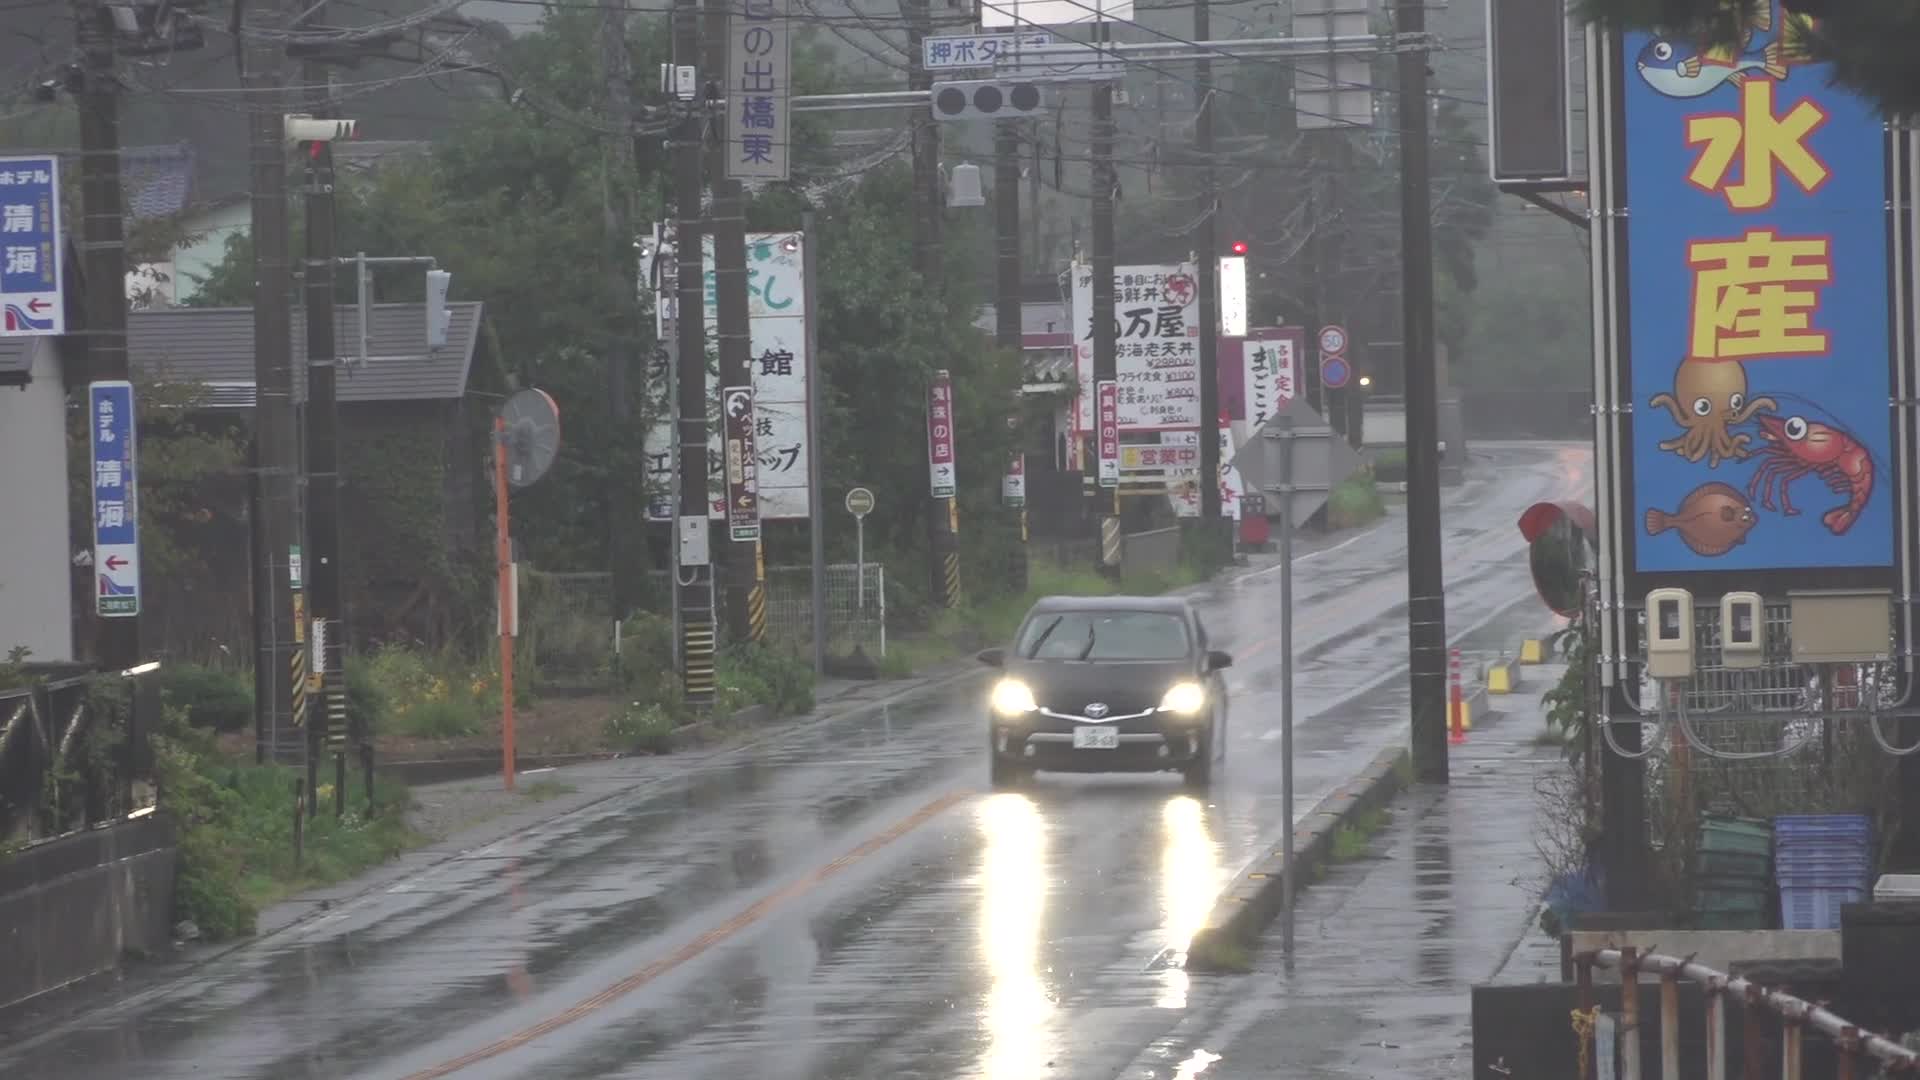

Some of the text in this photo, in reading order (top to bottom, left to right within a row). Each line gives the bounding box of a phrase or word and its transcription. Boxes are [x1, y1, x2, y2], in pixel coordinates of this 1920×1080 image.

[741, 0, 775, 164] 日の出橋東
[0, 170, 49, 185] ホテル
[1684, 75, 1832, 361] 水産
[1325, 334, 1341, 348] 50
[98, 400, 115, 443] ホテル
[1141, 448, 1195, 465] 営業中
